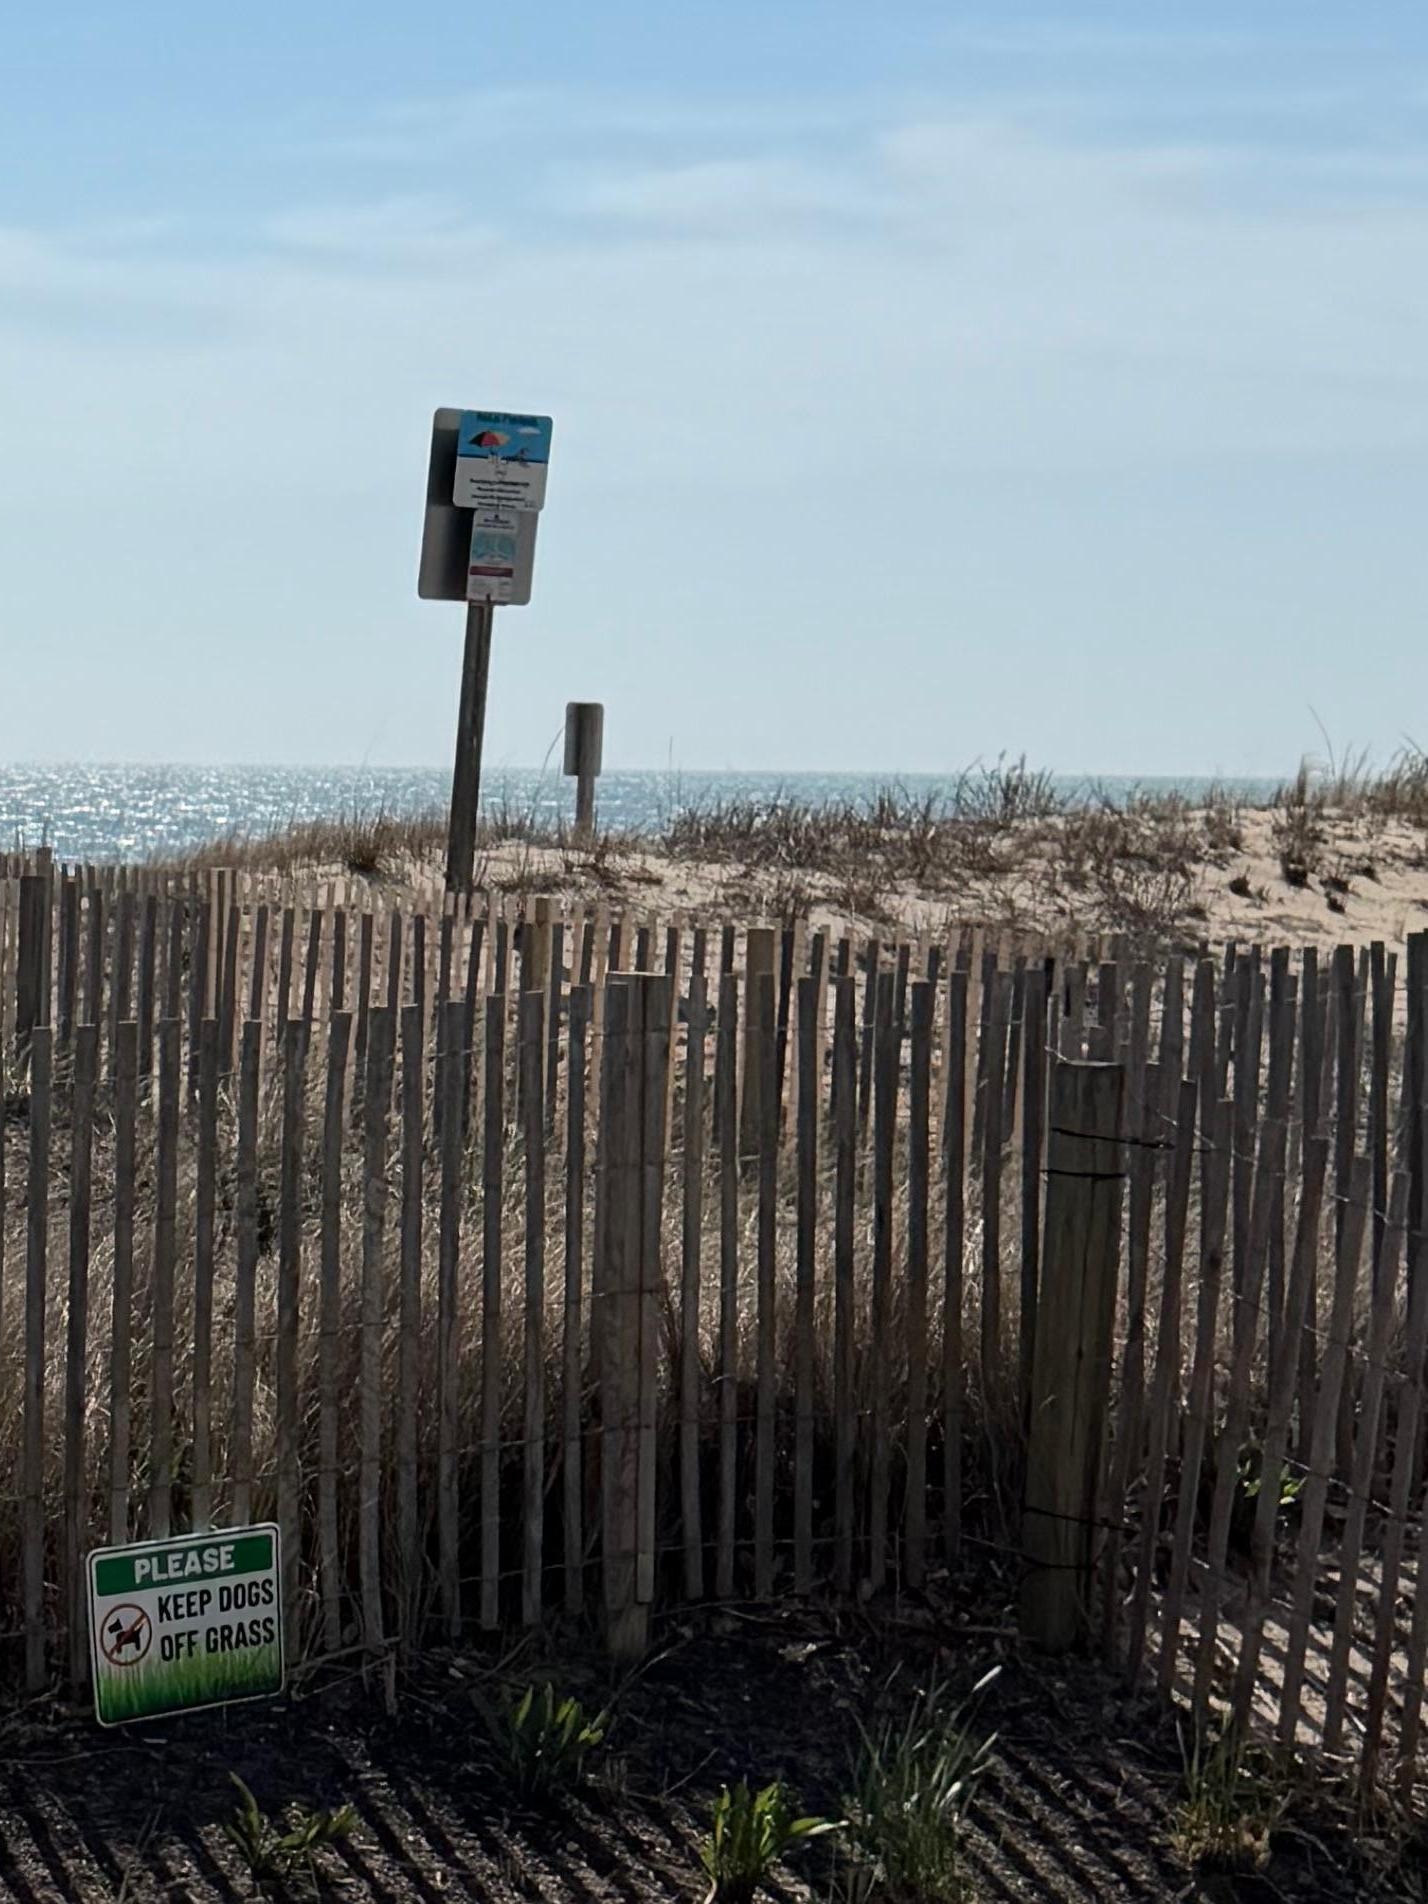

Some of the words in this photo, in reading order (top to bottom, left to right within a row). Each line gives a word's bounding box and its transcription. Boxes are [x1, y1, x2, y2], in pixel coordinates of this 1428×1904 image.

[134, 1545, 235, 1584] PLEASE
[158, 1589, 211, 1623] KEEP
[219, 1579, 274, 1612] DOGS
[160, 1630, 199, 1662] OFF
[206, 1617, 275, 1654] GRASS
